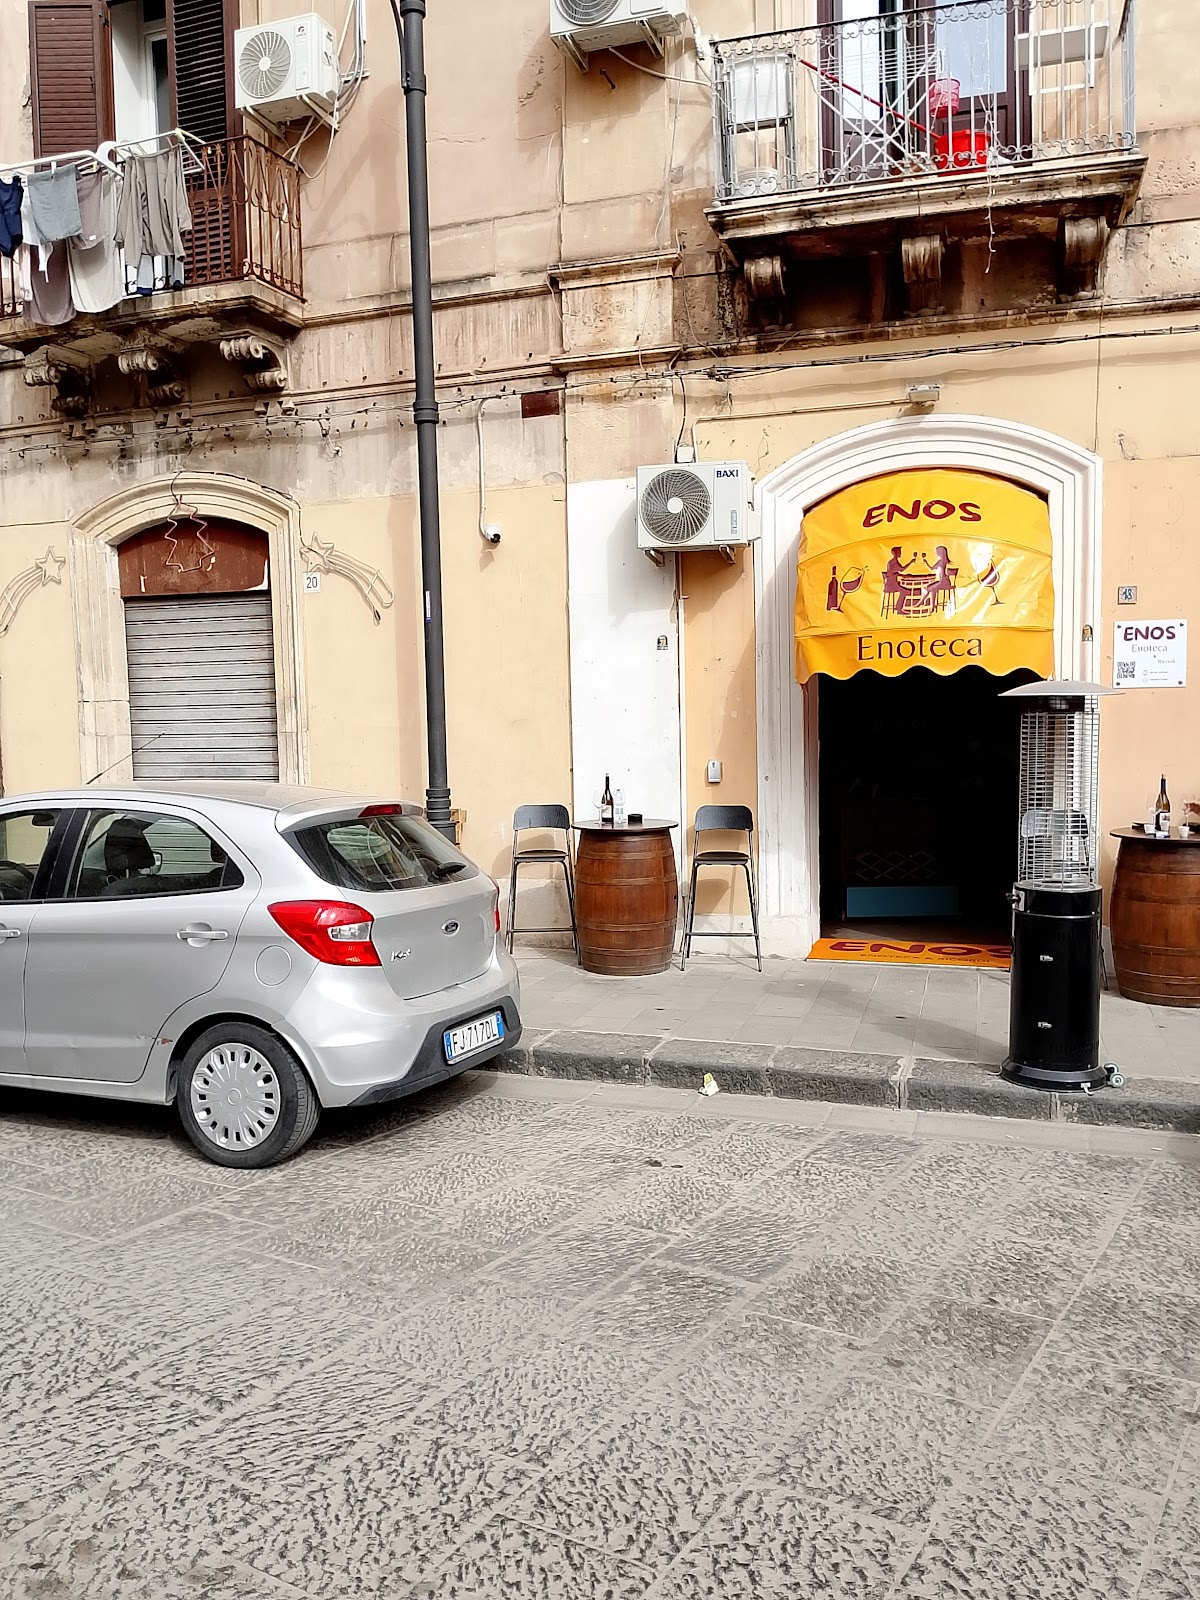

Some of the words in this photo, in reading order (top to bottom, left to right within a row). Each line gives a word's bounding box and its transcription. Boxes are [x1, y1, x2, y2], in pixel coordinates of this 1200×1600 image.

[716, 470, 739, 478] BAXI
[862, 500, 982, 528] ENOS
[306, 576, 318, 589] 20
[1123, 588, 1133, 600] 18
[1123, 626, 1176, 641] ENOS
[857, 635, 983, 661] Enoteca
[1131, 644, 1168, 653] Enoteca
